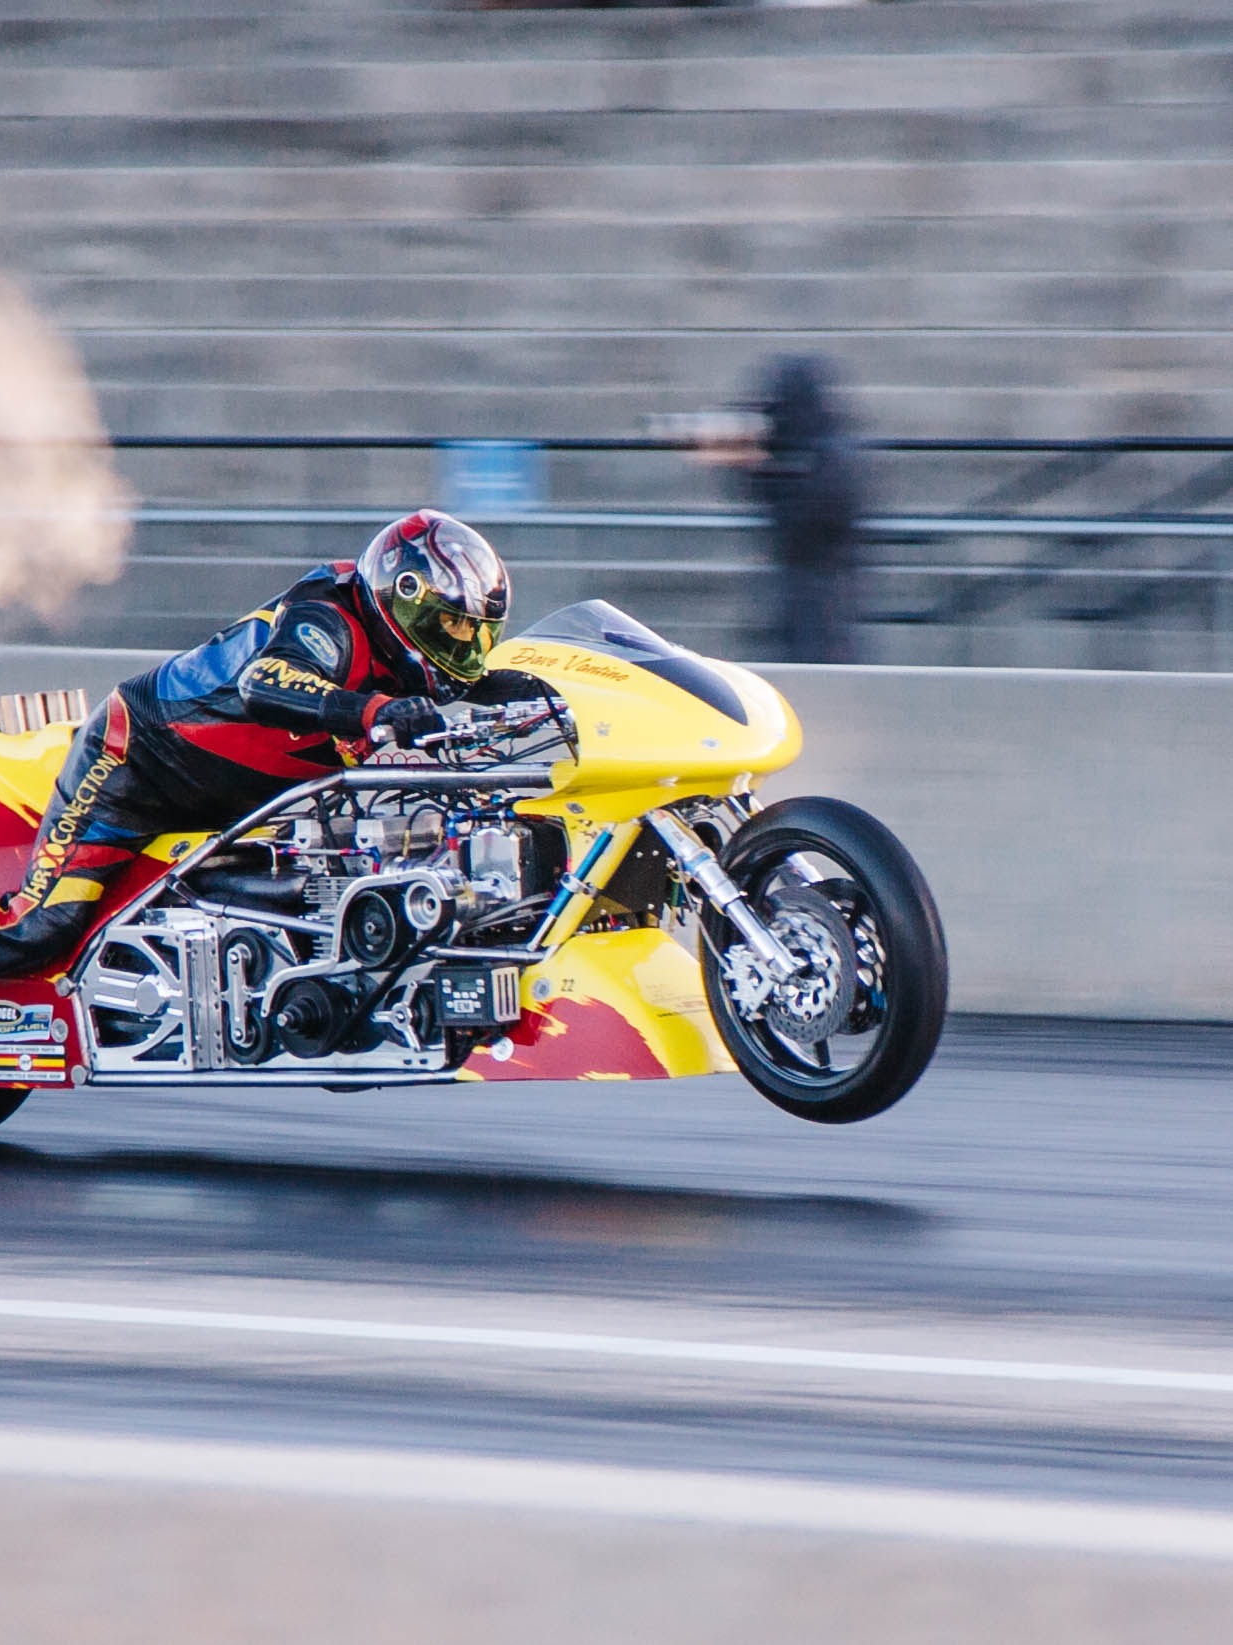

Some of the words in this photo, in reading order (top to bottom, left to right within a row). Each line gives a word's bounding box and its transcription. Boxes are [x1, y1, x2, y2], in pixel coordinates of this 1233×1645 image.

[509, 647, 559, 667] Dave
[563, 654, 630, 682] Vantine
[17, 1023, 47, 1032] FUEL
